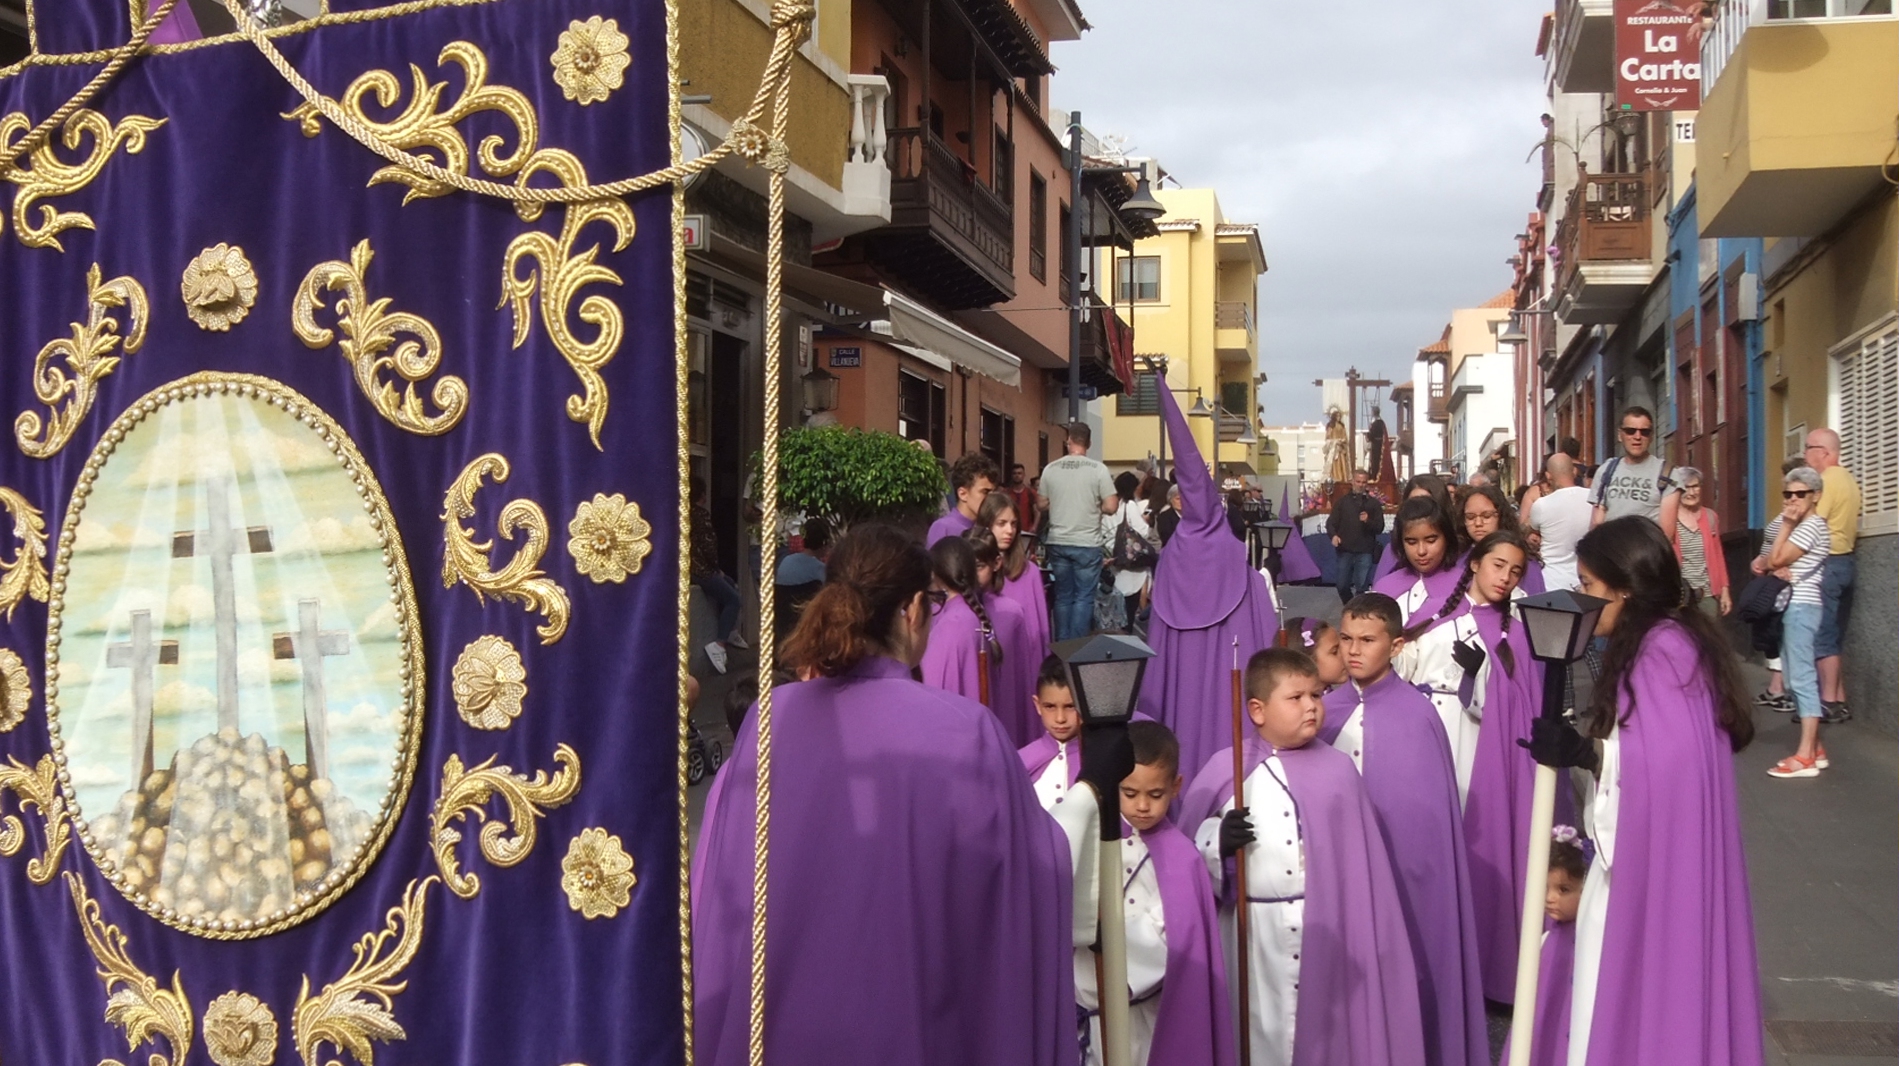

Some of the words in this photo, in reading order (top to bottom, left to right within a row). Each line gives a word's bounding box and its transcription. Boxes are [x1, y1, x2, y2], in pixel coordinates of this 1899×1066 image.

[1644, 29, 1677, 53] La
[1620, 57, 1701, 82] Carta
[1608, 488, 1651, 502] ONES
